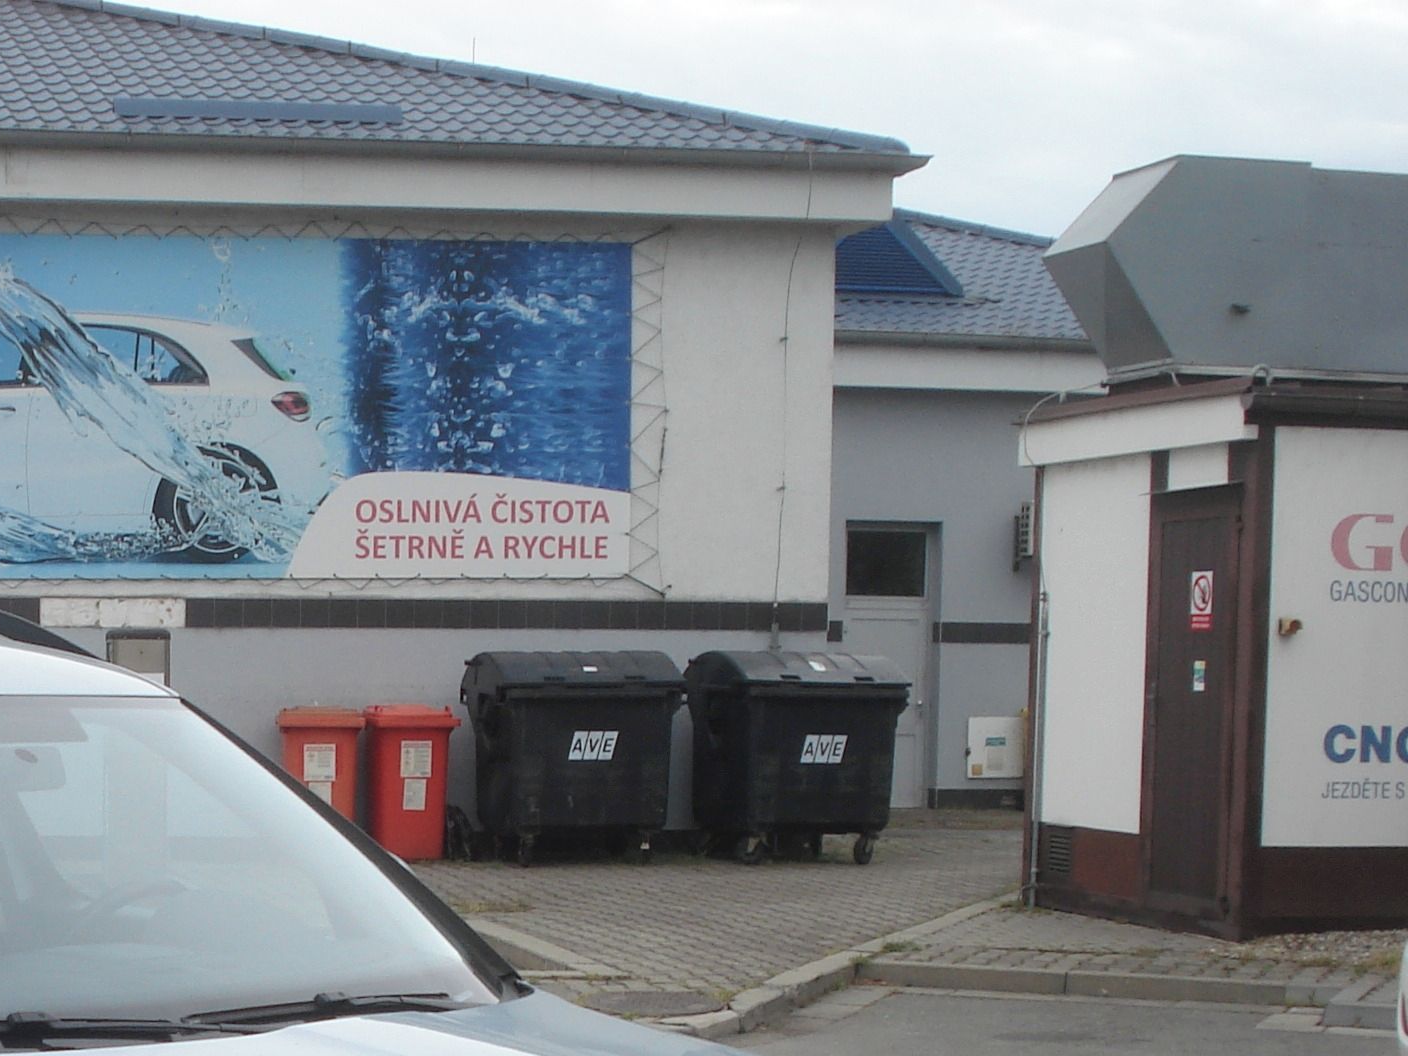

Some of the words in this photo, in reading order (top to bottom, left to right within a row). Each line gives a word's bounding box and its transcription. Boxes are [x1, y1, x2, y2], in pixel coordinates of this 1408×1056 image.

[355, 493, 482, 524] OSLNIVÁ
[490, 493, 610, 524] ČISTOTA
[355, 529, 465, 559] ŠETRNĚ
[473, 535, 494, 559] A
[503, 535, 609, 559] RYCHLE
[1330, 513, 1408, 572] G
[571, 736, 616, 754] AVE
[802, 740, 845, 758] AVE
